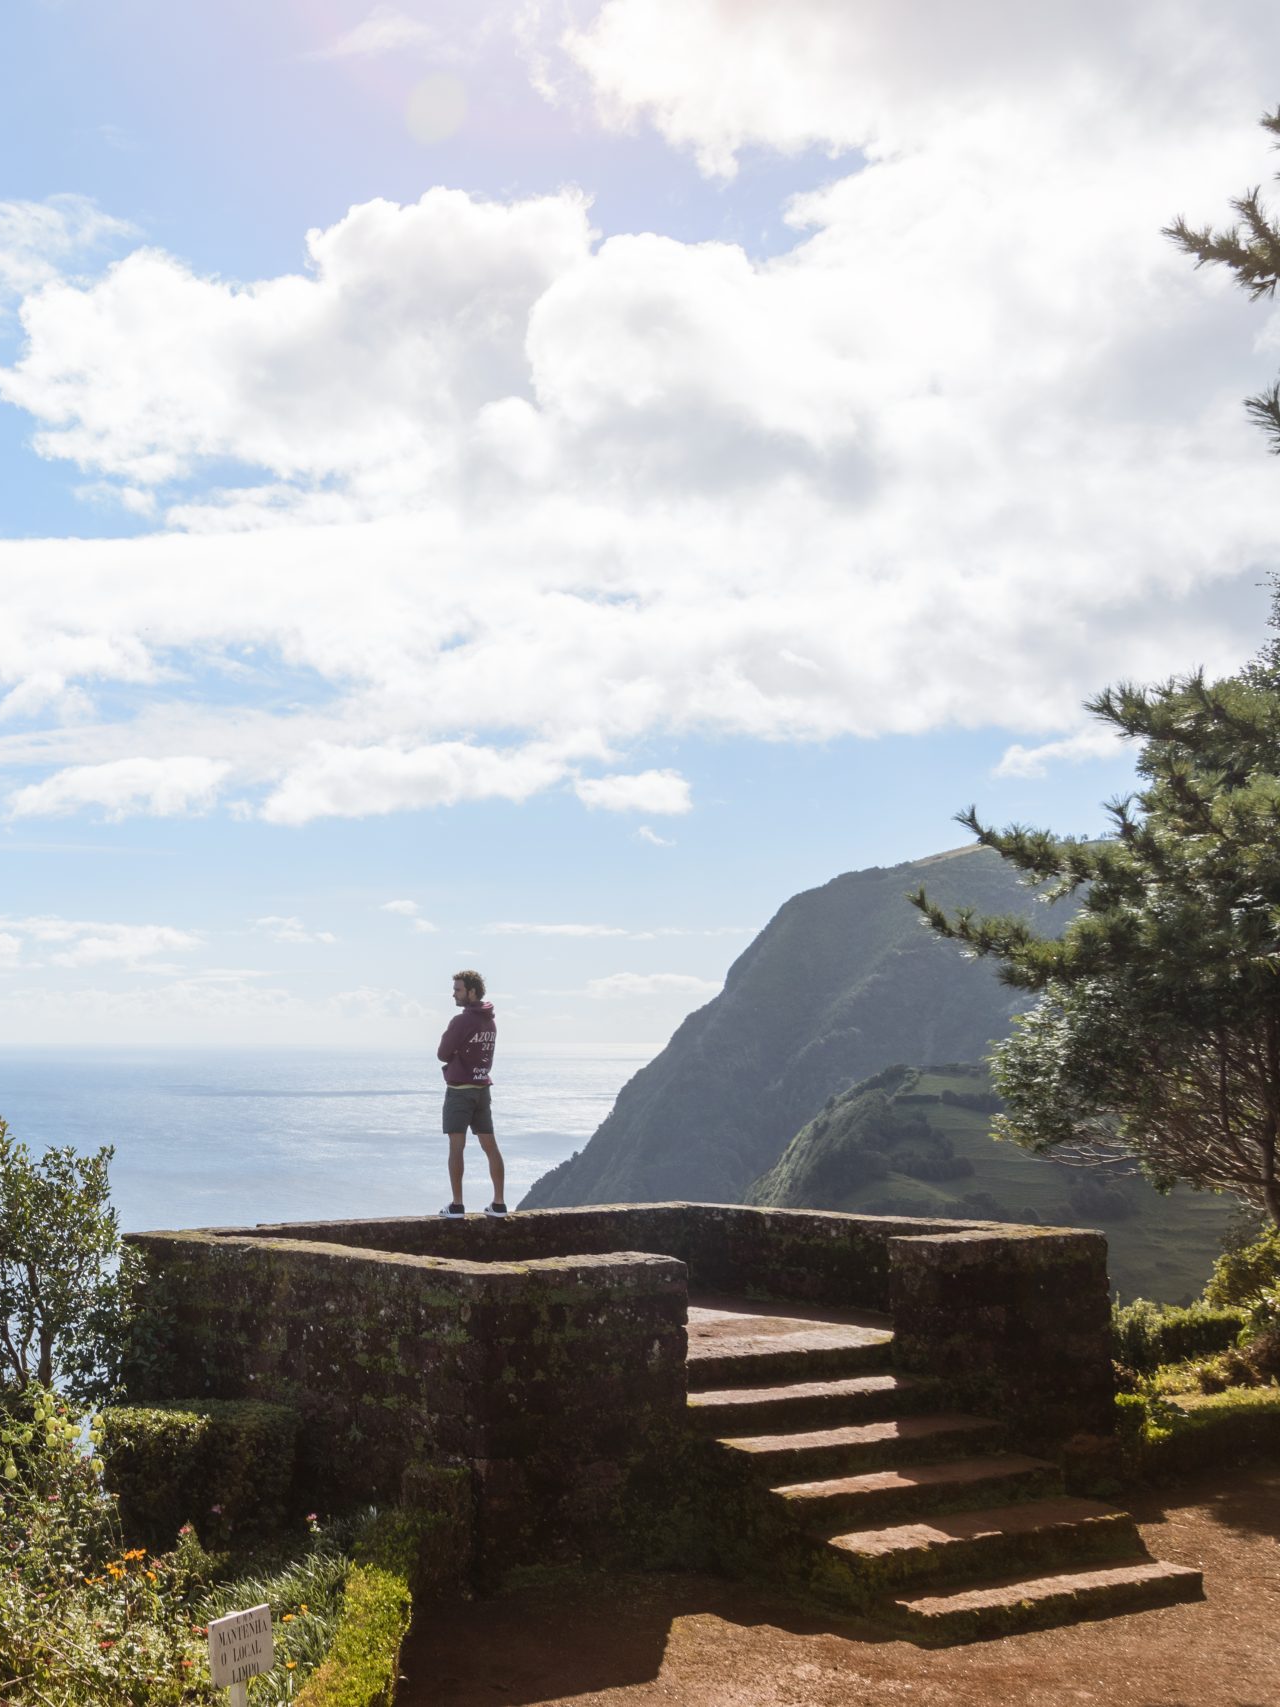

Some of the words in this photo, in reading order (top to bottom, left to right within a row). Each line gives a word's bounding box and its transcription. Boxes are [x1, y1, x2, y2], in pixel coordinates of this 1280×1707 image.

[219, 1618, 267, 1646] MANTENHA
[221, 1652, 227, 1665] O
[233, 1640, 261, 1662] LOCAL
[232, 1662, 259, 1683] LIMPO
